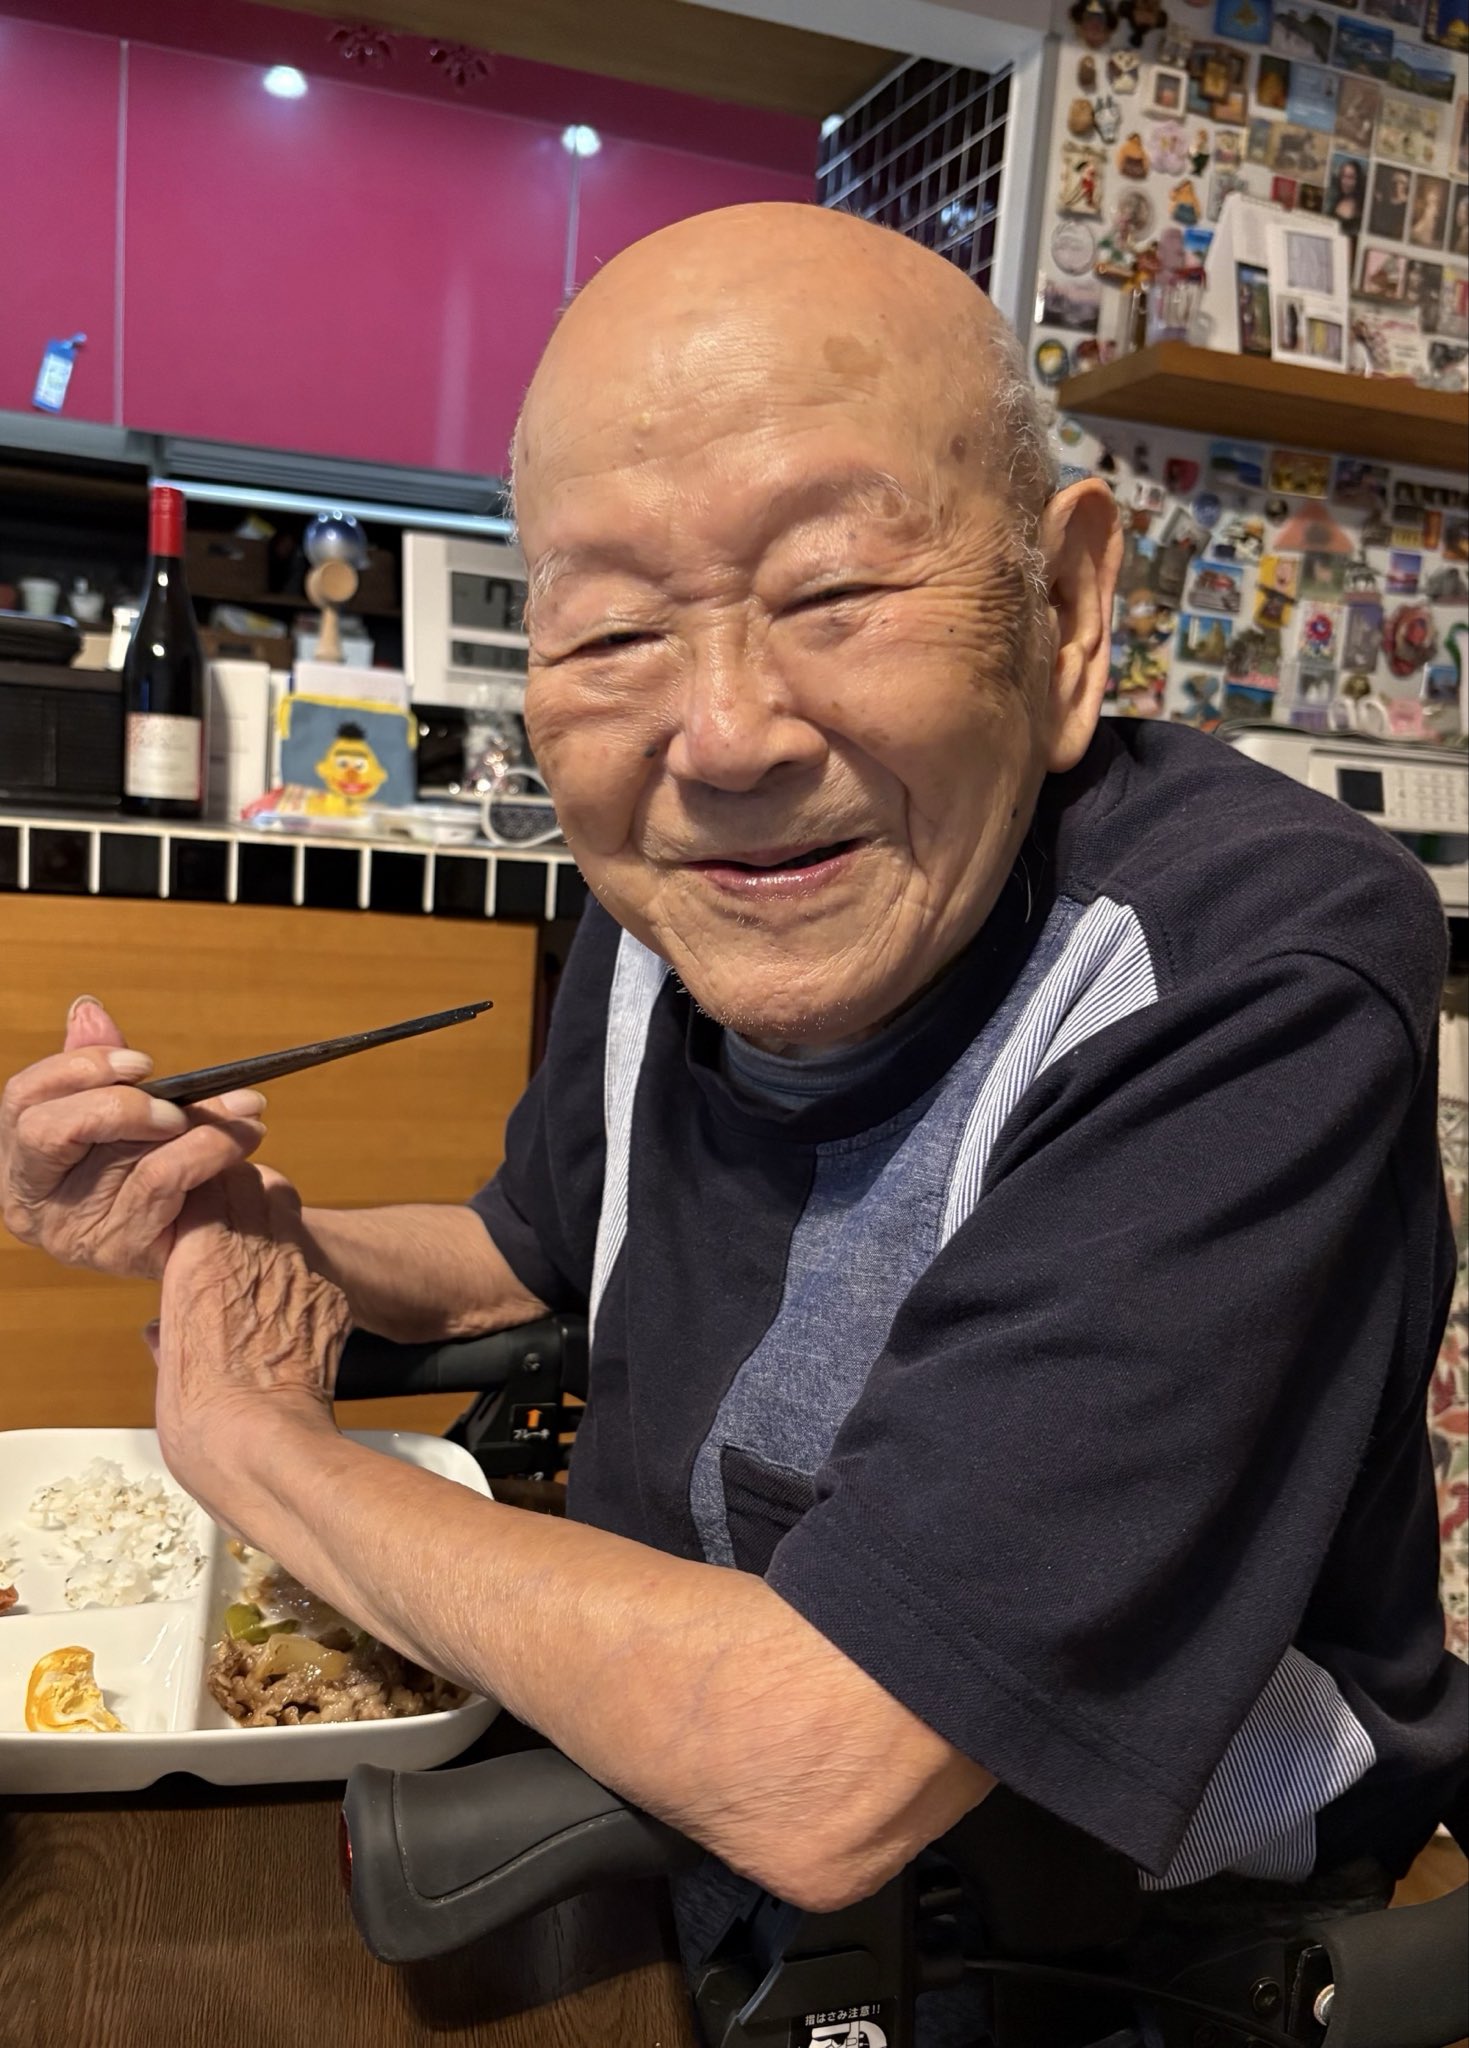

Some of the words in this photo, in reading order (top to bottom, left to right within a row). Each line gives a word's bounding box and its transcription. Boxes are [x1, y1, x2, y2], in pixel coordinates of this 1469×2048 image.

[805, 2003, 881, 2026] 指はさみ注意!!
